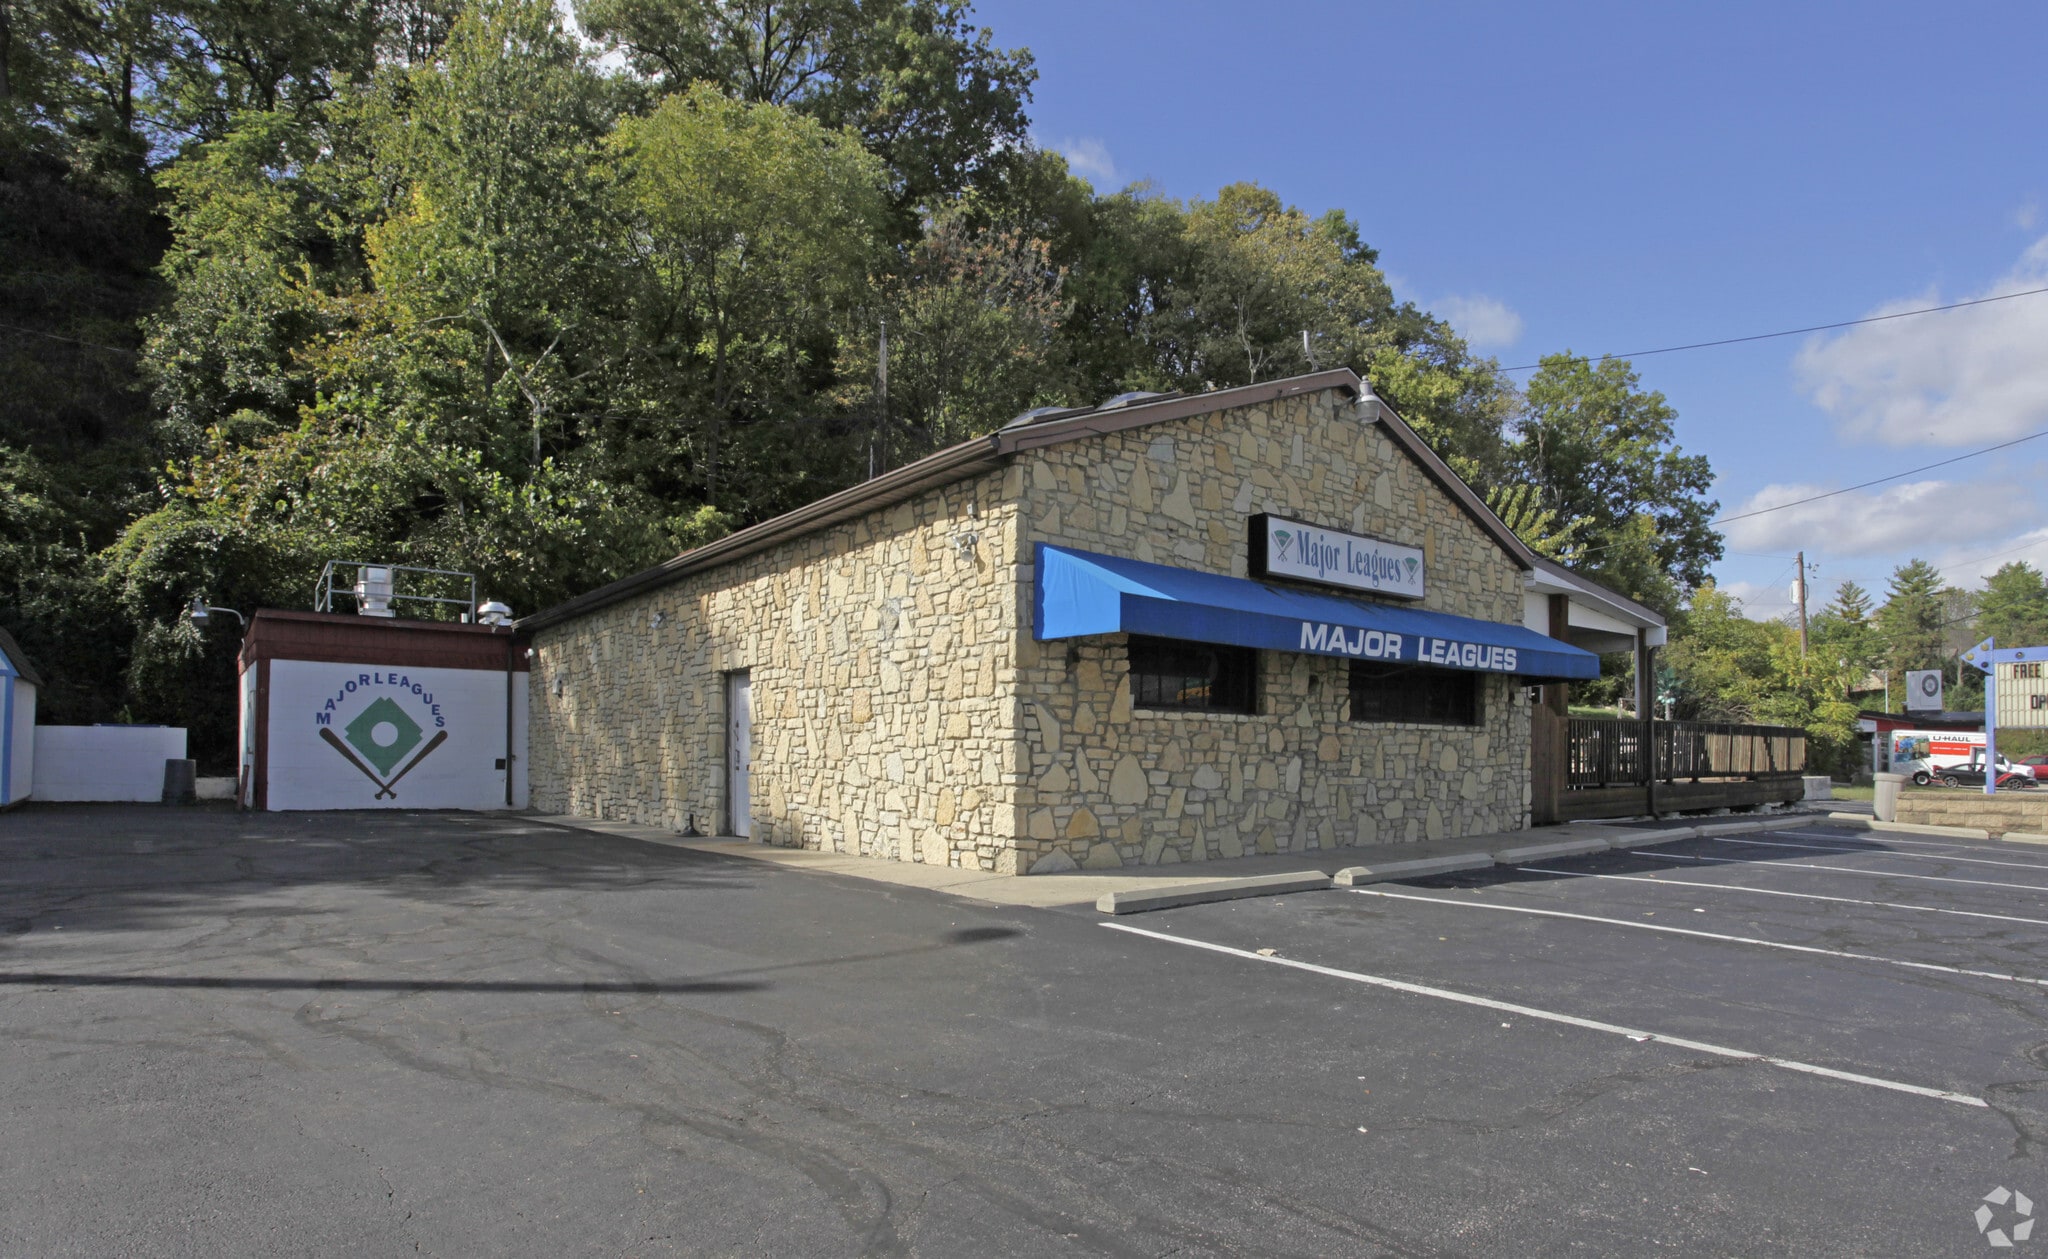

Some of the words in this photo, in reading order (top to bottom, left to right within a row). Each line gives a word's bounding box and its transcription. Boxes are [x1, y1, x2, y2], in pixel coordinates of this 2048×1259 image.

[1297, 530, 1340, 577] Major
[1347, 540, 1401, 587] Leagues
[1300, 622, 1401, 659] MAJOR
[1417, 637, 1517, 671] LEAGUES
[2013, 663, 2041, 679] FREE
[2030, 694, 2048, 709] OP
